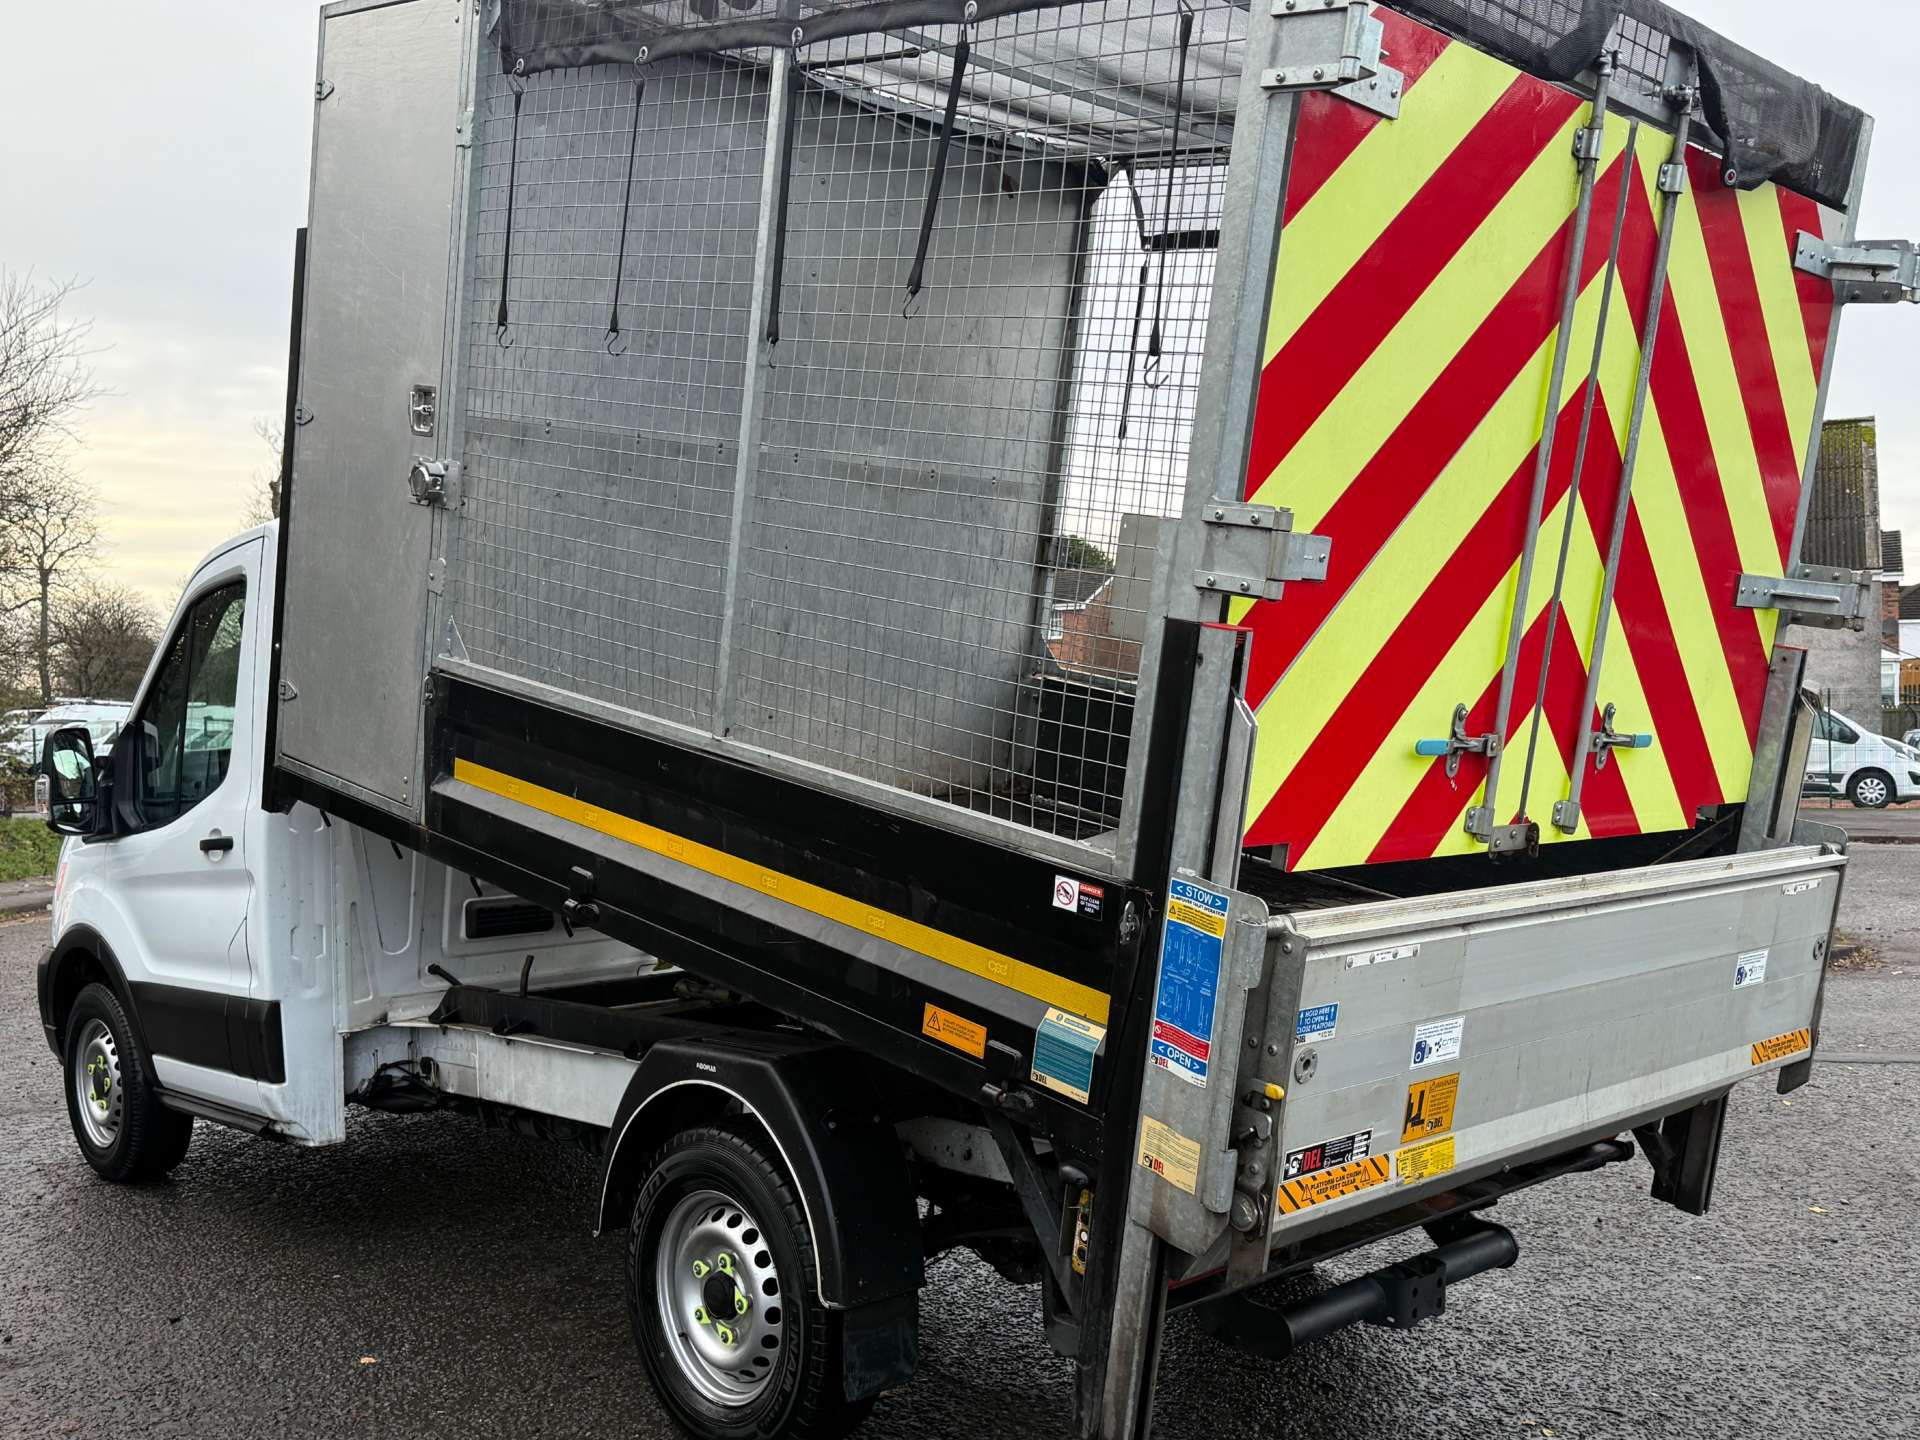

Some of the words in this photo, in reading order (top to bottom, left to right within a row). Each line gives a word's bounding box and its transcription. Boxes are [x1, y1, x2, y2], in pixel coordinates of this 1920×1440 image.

[1186, 886, 1213, 905] STOW
[1312, 1015, 1325, 1023] OPEN
[1158, 1056, 1168, 1069] DEL
[1167, 1047, 1191, 1068] OPEN
[1153, 1158, 1164, 1176] DEL
[1302, 1148, 1322, 1172] DEL
[1310, 1177, 1335, 1191] PLATFORM
[1335, 1173, 1346, 1183] CAN
[1316, 1184, 1330, 1195] KEEP
[1330, 1180, 1342, 1191] FEET
[1342, 1175, 1356, 1187] CLEAR
